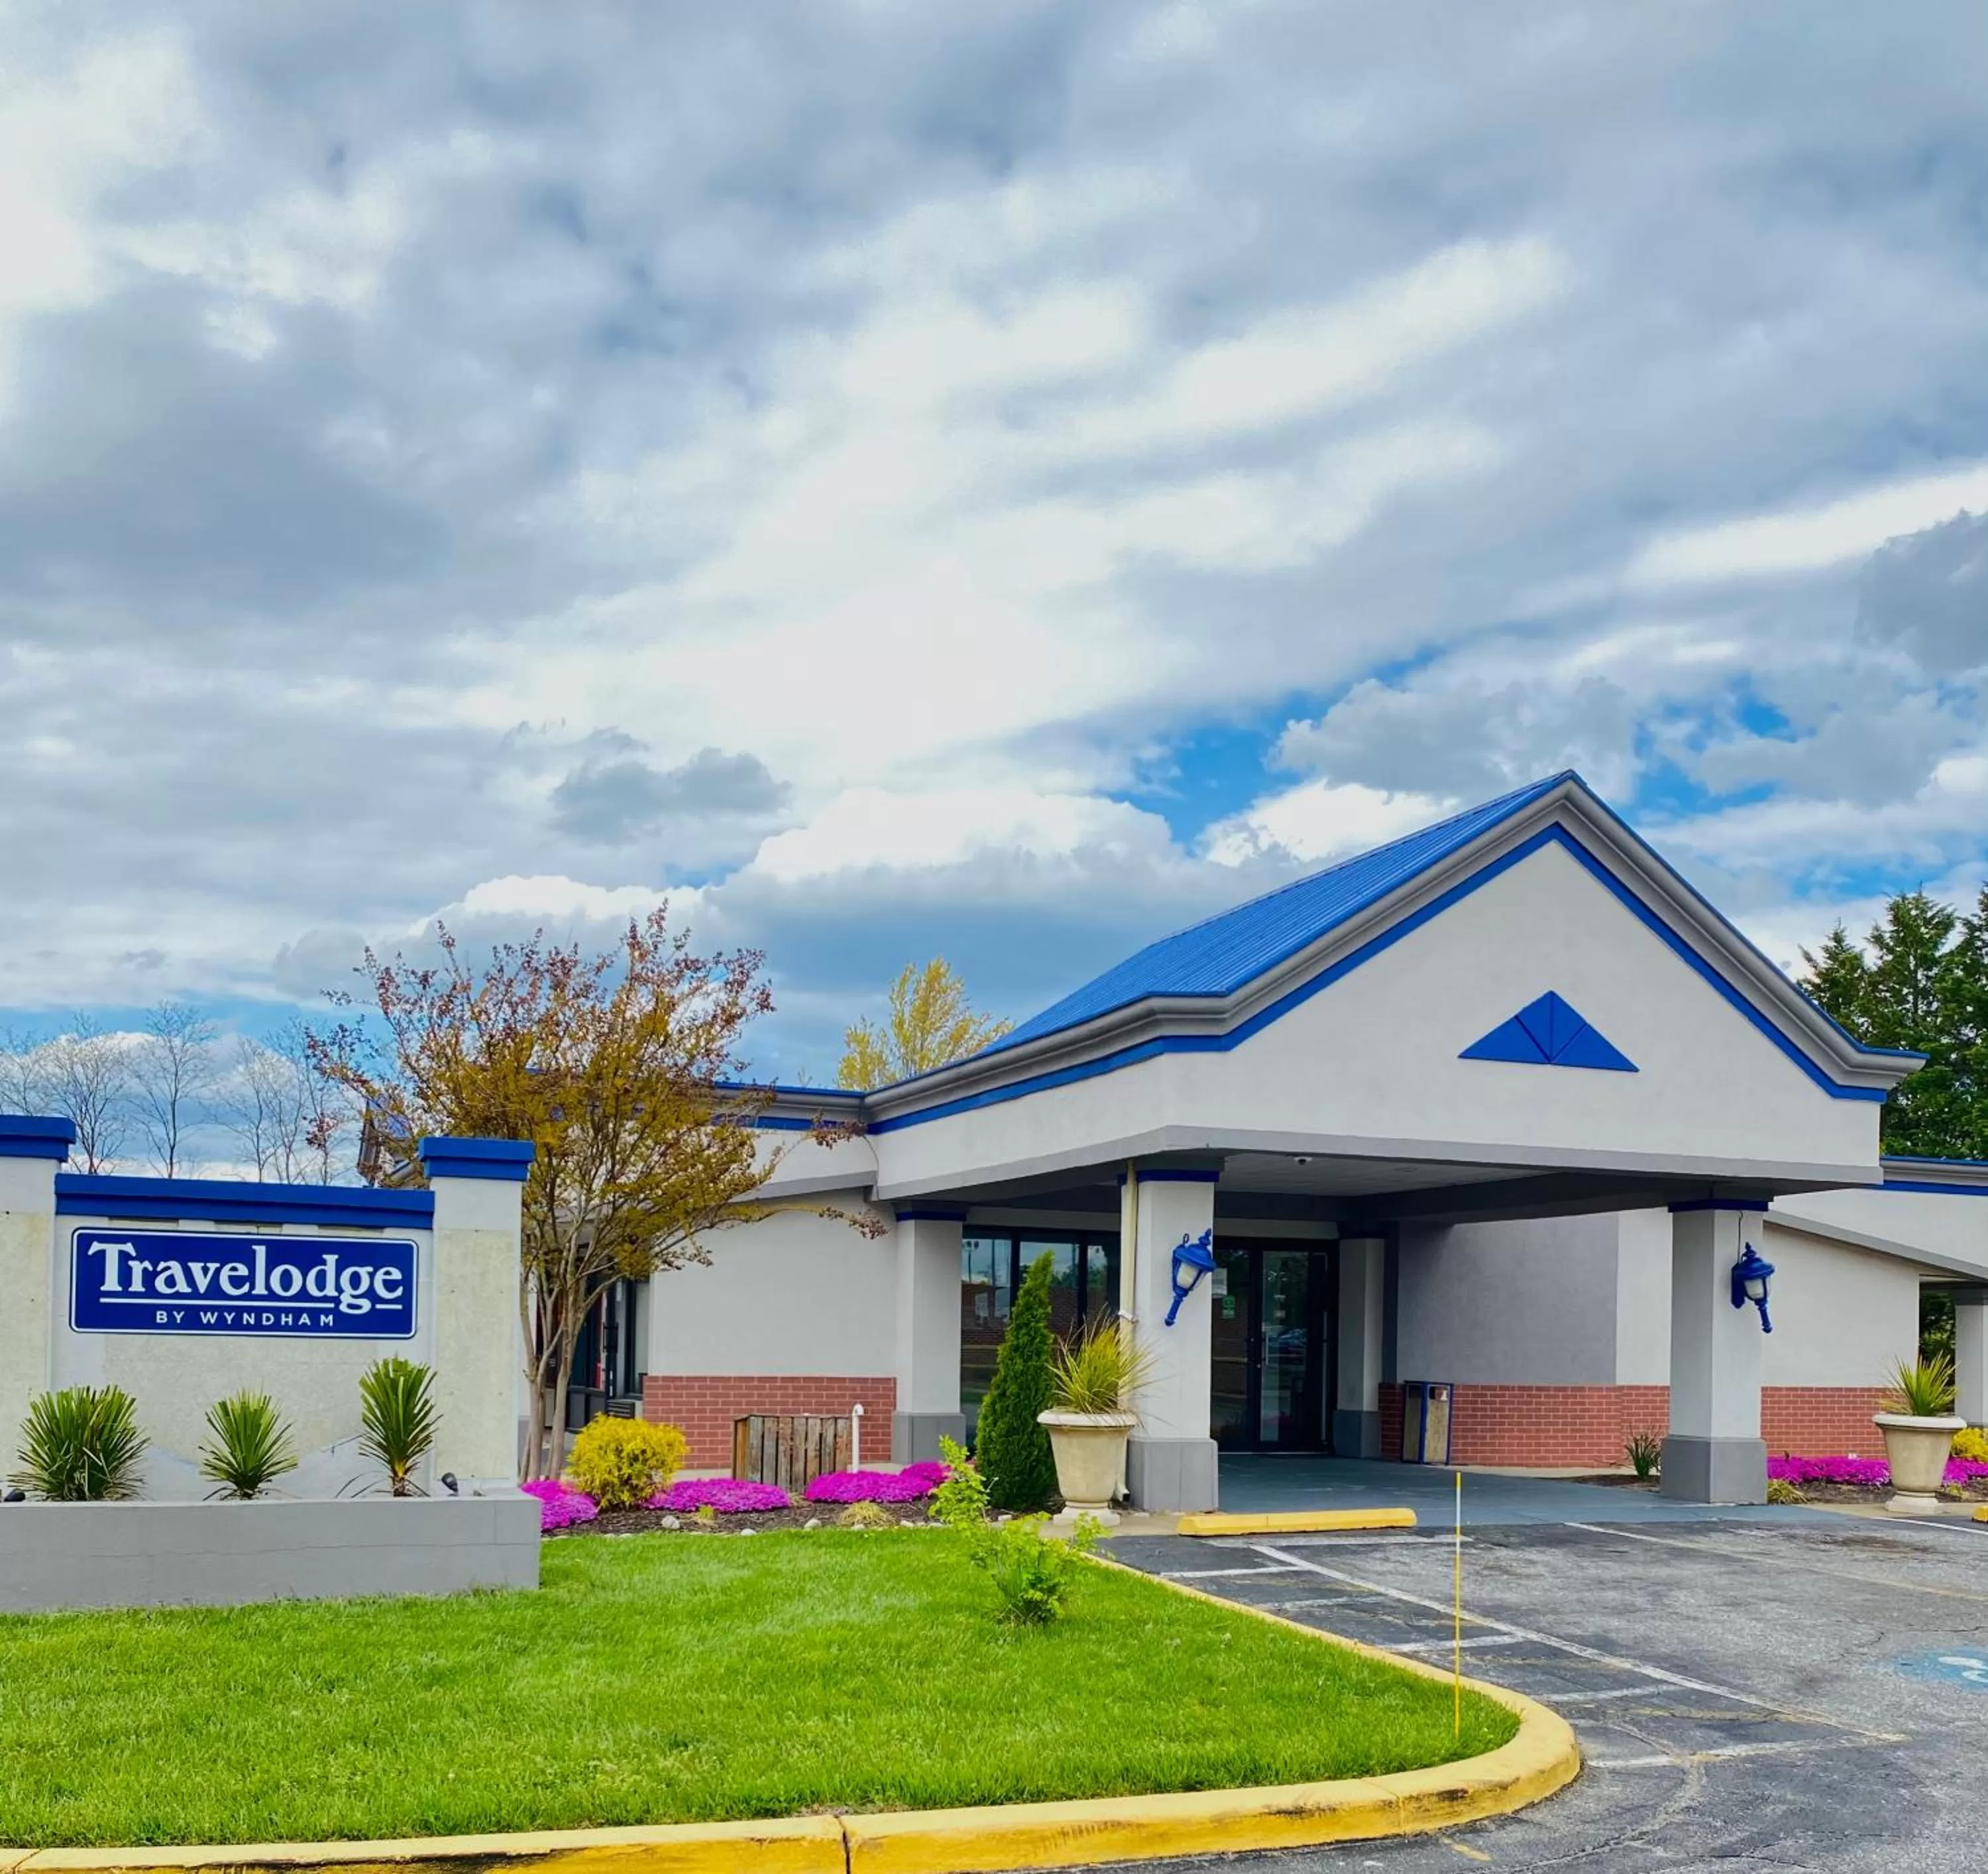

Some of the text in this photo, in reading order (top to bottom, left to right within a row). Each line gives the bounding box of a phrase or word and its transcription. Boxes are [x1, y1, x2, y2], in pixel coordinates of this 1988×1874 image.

[87, 1240, 404, 1314] Travelodge
[155, 1311, 334, 1327] BY WYNDHAM
